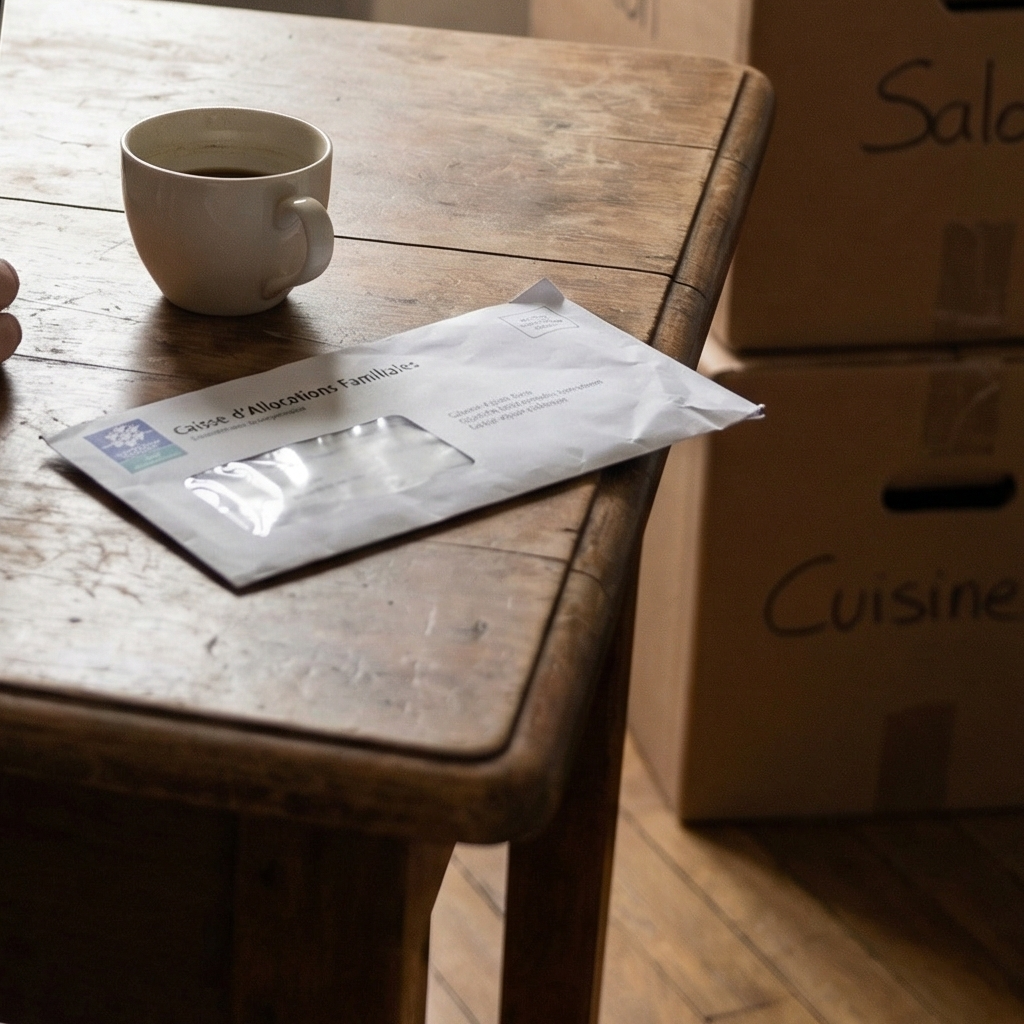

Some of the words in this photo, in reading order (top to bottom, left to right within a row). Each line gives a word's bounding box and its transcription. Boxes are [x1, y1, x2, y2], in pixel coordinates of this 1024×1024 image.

[173, 415, 230, 436] Caisse
[232, 383, 338, 419] d'Allocations
[763, 552, 1024, 638] Cuisine
